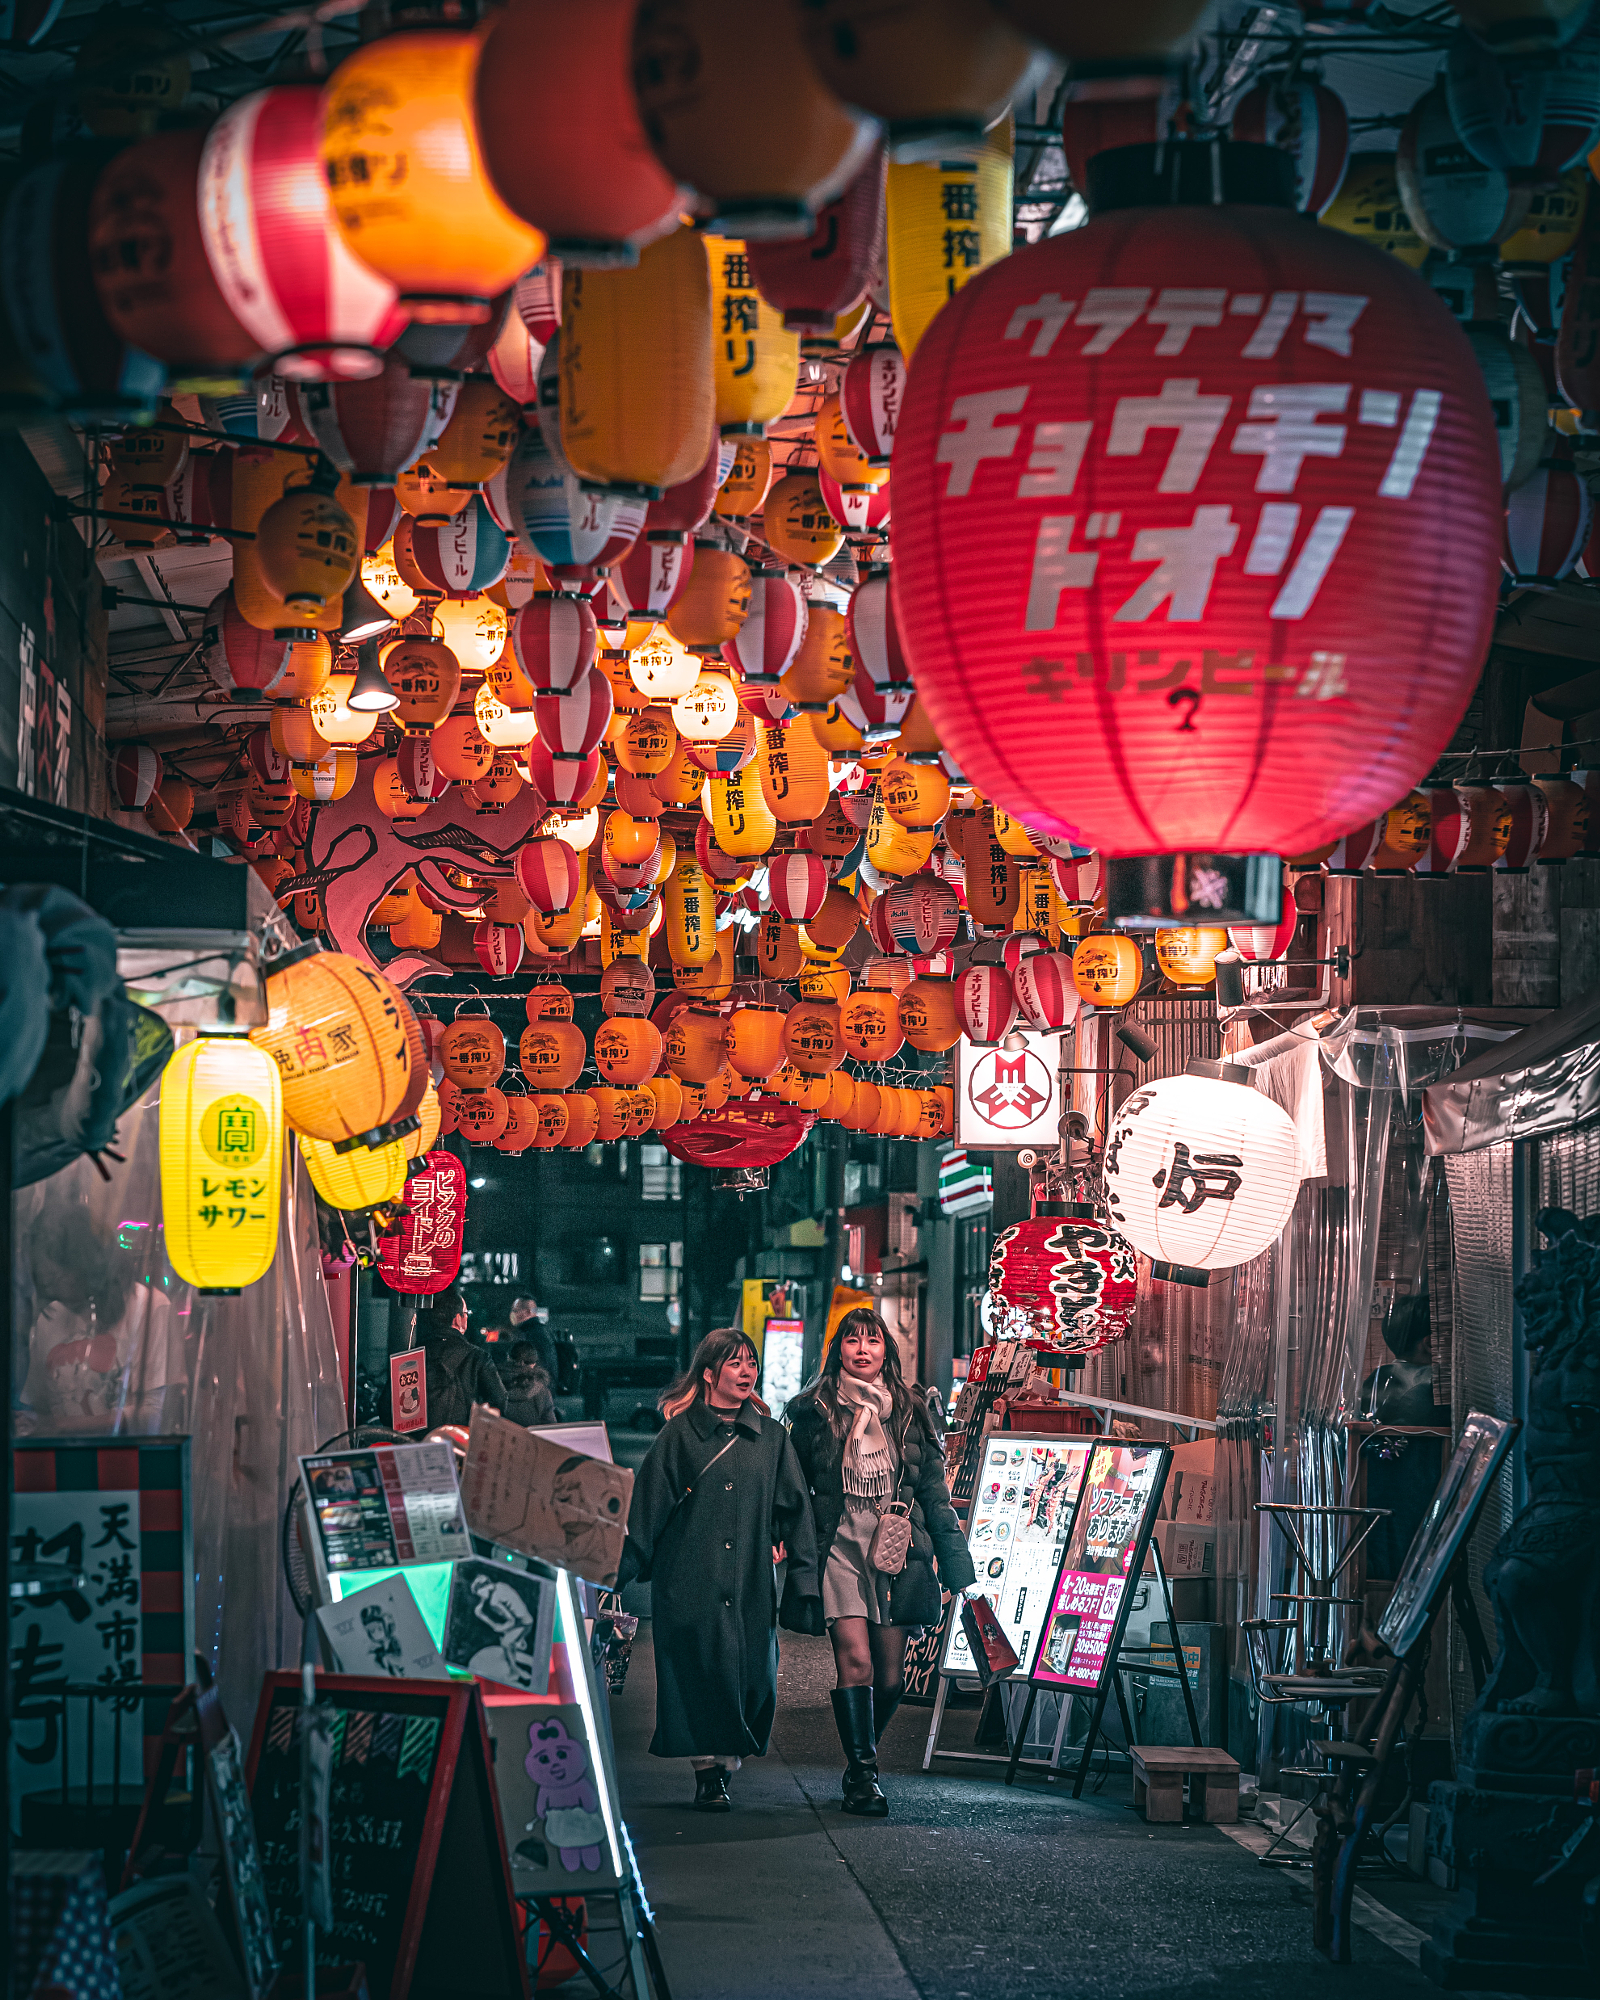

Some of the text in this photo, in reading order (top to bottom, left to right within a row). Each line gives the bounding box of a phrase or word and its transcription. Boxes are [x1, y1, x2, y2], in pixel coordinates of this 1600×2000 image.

[1004, 287, 1369, 358] ウラテンマ
[882, 360, 897, 435] キリンビール
[936, 377, 1443, 500] チョウチン
[1024, 502, 1355, 633] ドオリ
[633, 656, 673, 667] 一番搾り
[1021, 649, 1350, 703] キリンビール
[391, 679, 439, 692] 一番搾り
[685, 702, 726, 713] 一番搾り
[628, 738, 668, 749] 一番搾り
[419, 739, 430, 787] キリンビール
[683, 888, 701, 951] 一番搾り
[891, 909, 909, 918] Asahi
[922, 889, 934, 939] アサヒビール
[1078, 968, 1118, 979] 一番搾り
[972, 973, 983, 1027] キリンビール
[1018, 967, 1041, 1019] キリンビール
[845, 1024, 886, 1035] 一番搾り
[791, 1038, 834, 1050] 一番搾り
[451, 1053, 490, 1063] 一番搾り
[522, 1053, 560, 1063] 一番搾り
[596, 1048, 628, 1059] 一番搾り
[463, 1111, 494, 1120] 一番搾り
[539, 1119, 565, 1127] 一番搾り
[200, 1177, 267, 1199] レモン
[198, 1205, 267, 1228] サワー
[400, 1371, 418, 1387] おでん
[1090, 1488, 1144, 1517] ソファー席
[1086, 1514, 1130, 1544] あります
[1106, 1583, 1122, 1599] 貸切
[91, 1503, 144, 1714] 天満市場
[1103, 1600, 1116, 1615] OK
